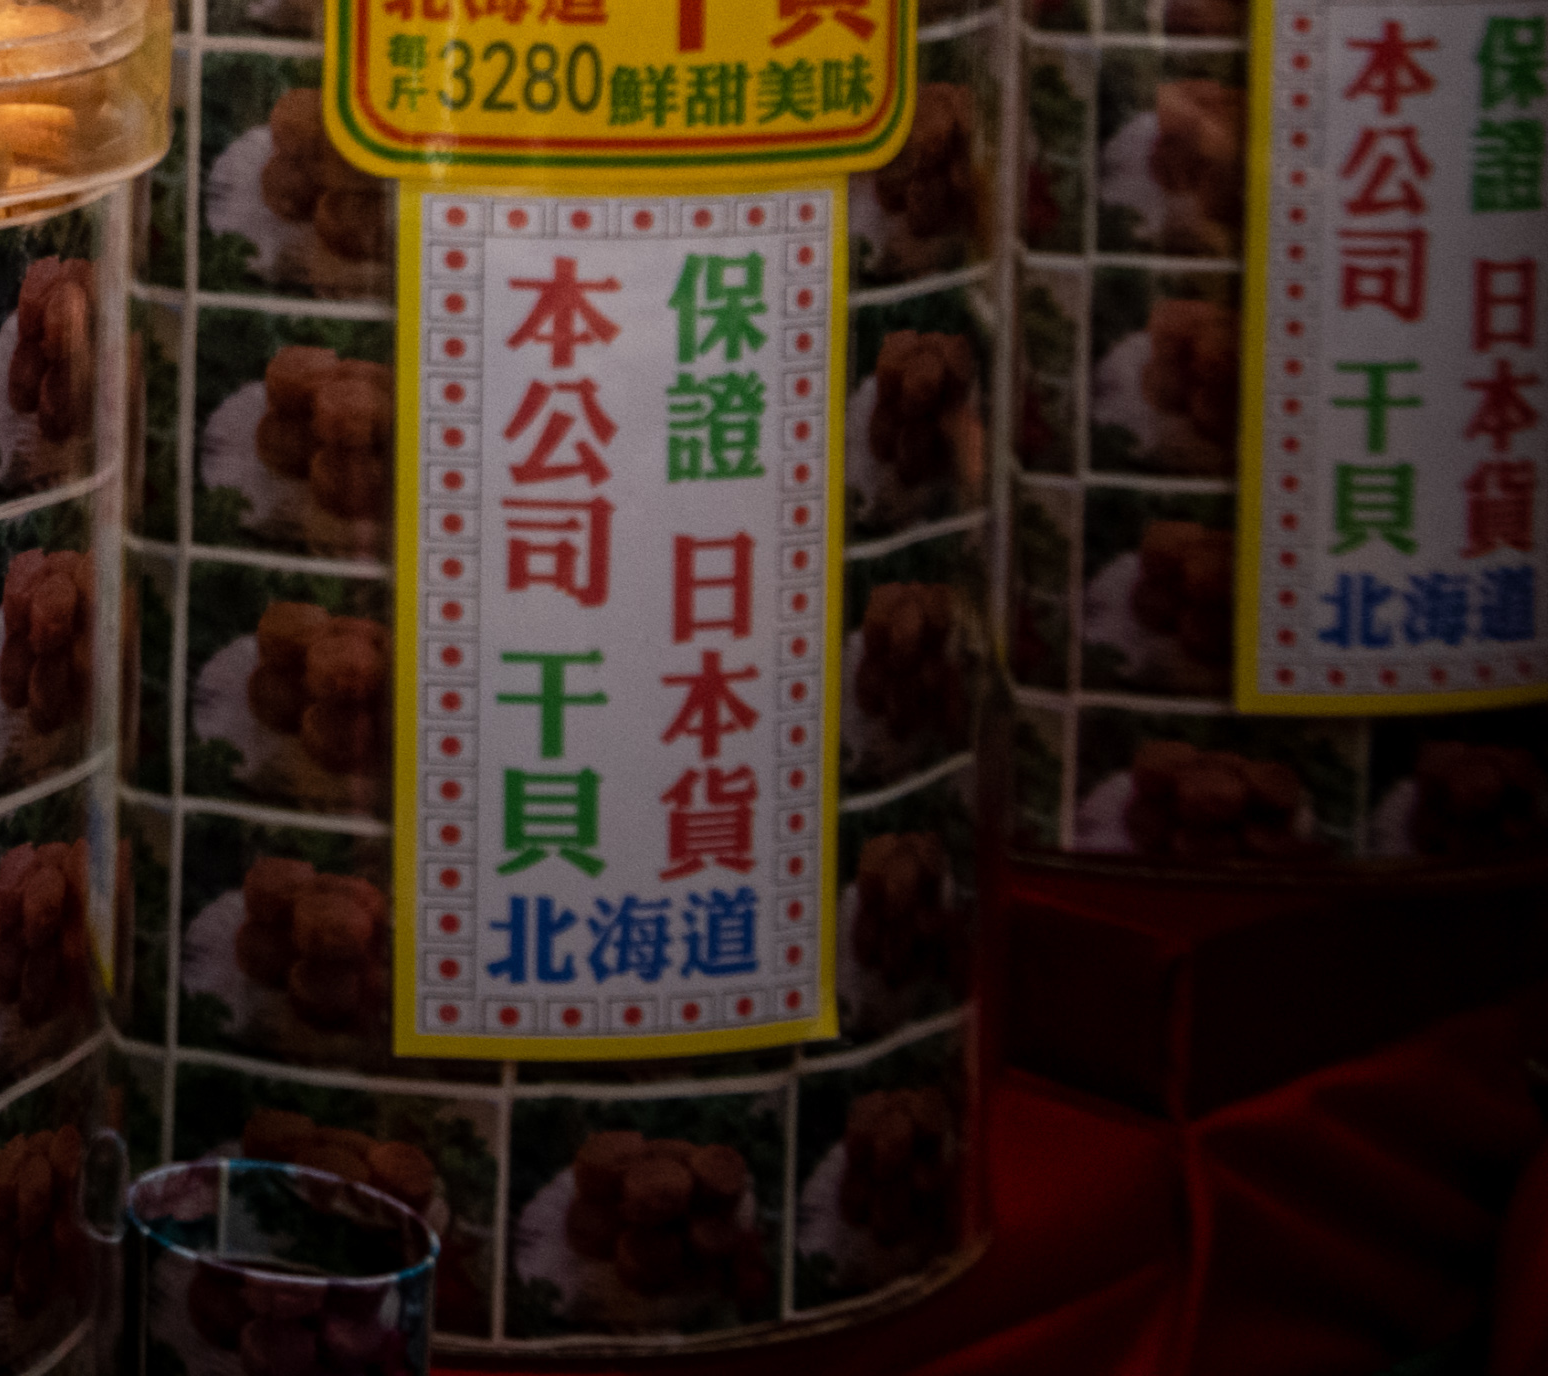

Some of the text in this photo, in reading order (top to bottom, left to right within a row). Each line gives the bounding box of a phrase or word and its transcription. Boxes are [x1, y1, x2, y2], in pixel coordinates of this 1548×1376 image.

[437, 41, 603, 114] 3280
[608, 53, 874, 128] 鮮甜美味
[1330, 20, 1438, 556] 本公司 干貝
[494, 256, 621, 879] 本公司 干貝
[660, 252, 768, 882] 保證 日本貨
[486, 888, 762, 986] 北海道
